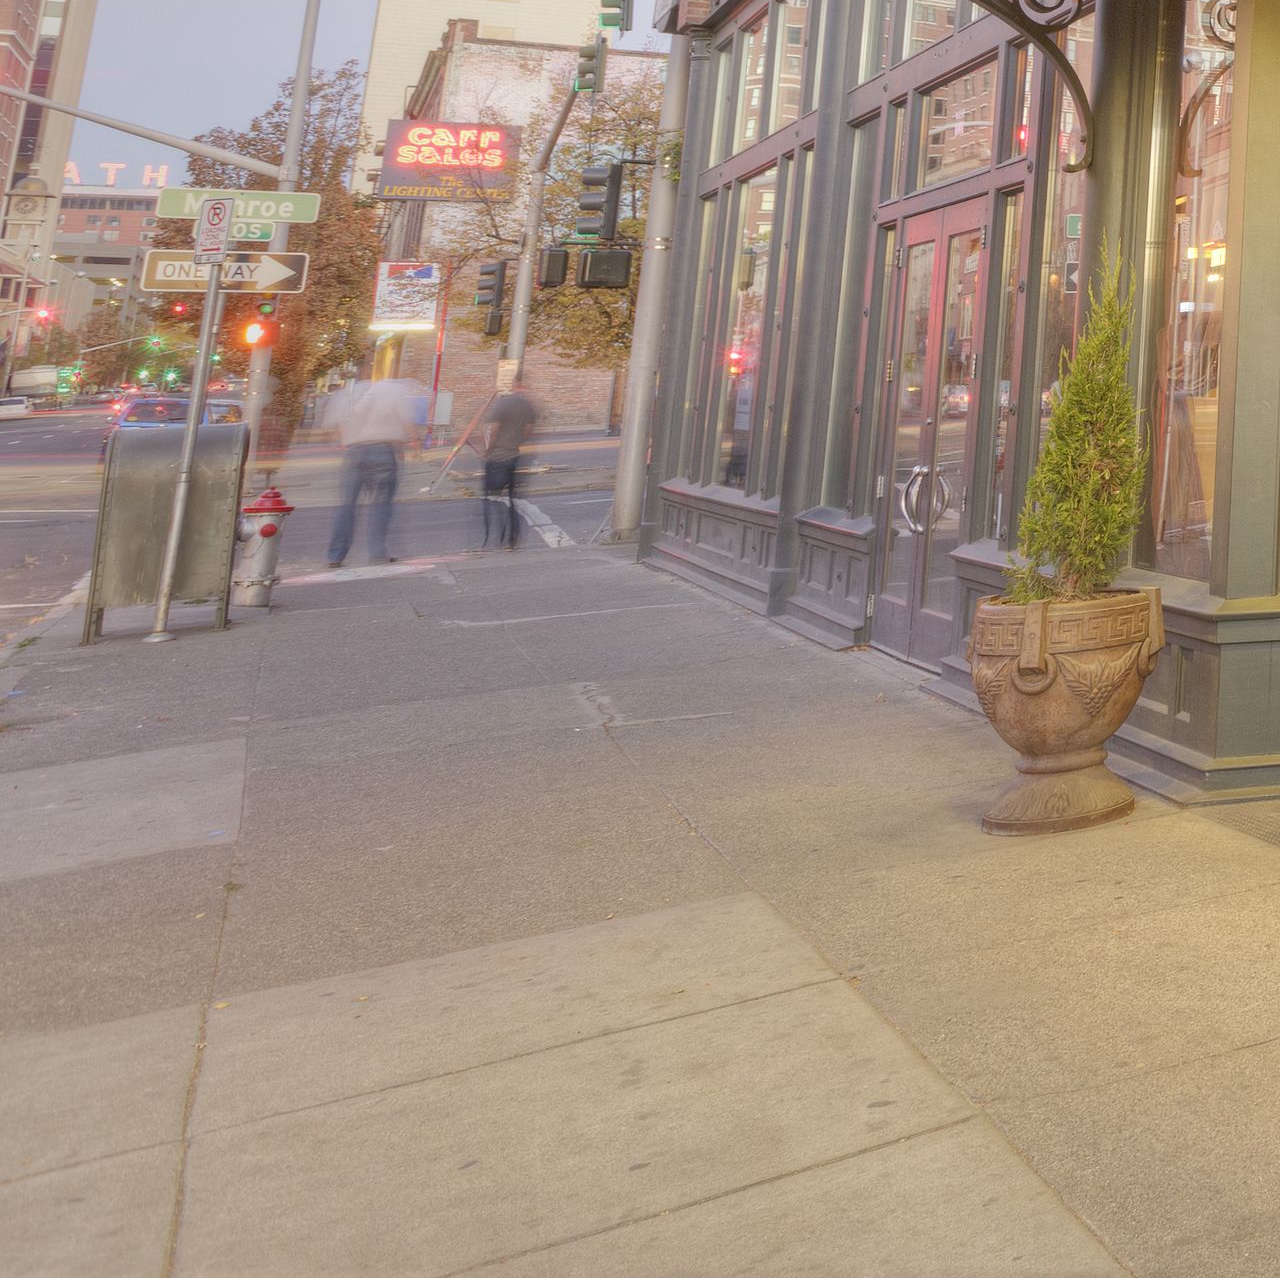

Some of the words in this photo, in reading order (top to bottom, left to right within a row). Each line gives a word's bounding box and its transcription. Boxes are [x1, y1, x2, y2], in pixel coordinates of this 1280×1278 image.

[383, 185, 452, 198] LIGHTING
[184, 193, 295, 218] Mnroe
[163, 263, 205, 279] ONE
